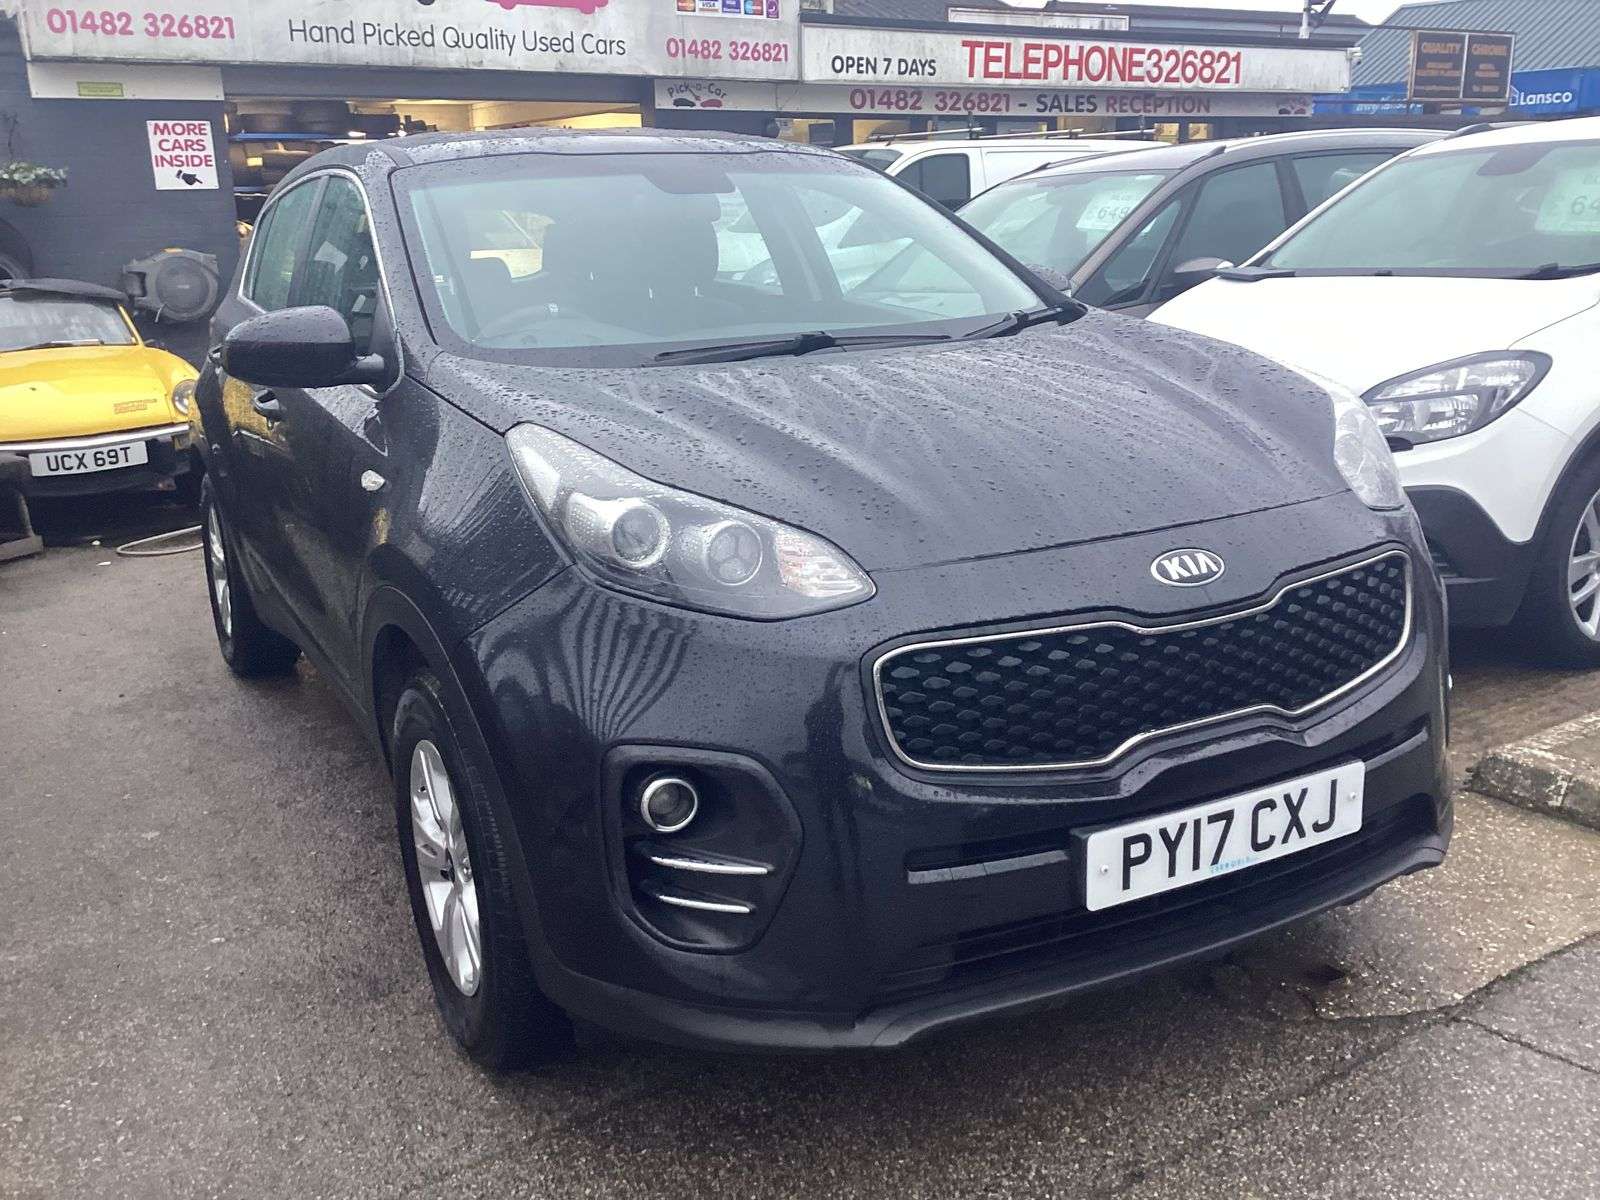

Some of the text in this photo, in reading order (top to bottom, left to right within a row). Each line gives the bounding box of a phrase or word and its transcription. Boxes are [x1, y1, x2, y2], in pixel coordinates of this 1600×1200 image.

[47, 9, 236, 40] 01482 326821
[289, 19, 627, 57] Hand Picked Quality Used Cars
[666, 38, 789, 63] 01482 326821
[831, 54, 937, 77] OPEN 7 DAYS
[849, 88, 923, 111] 01482
[934, 91, 1011, 112] 326821
[1035, 94, 1098, 113] SALES
[1105, 95, 1211, 114] RECEPTION
[1519, 90, 1573, 106] Lansco
[153, 122, 208, 137] MORE
[158, 138, 207, 153] CARS
[154, 153, 214, 169] INSIDE
[46, 446, 131, 472] UCX 69T
[1159, 552, 1220, 581] KIA
[1121, 778, 1338, 891] PY17 CXJ
